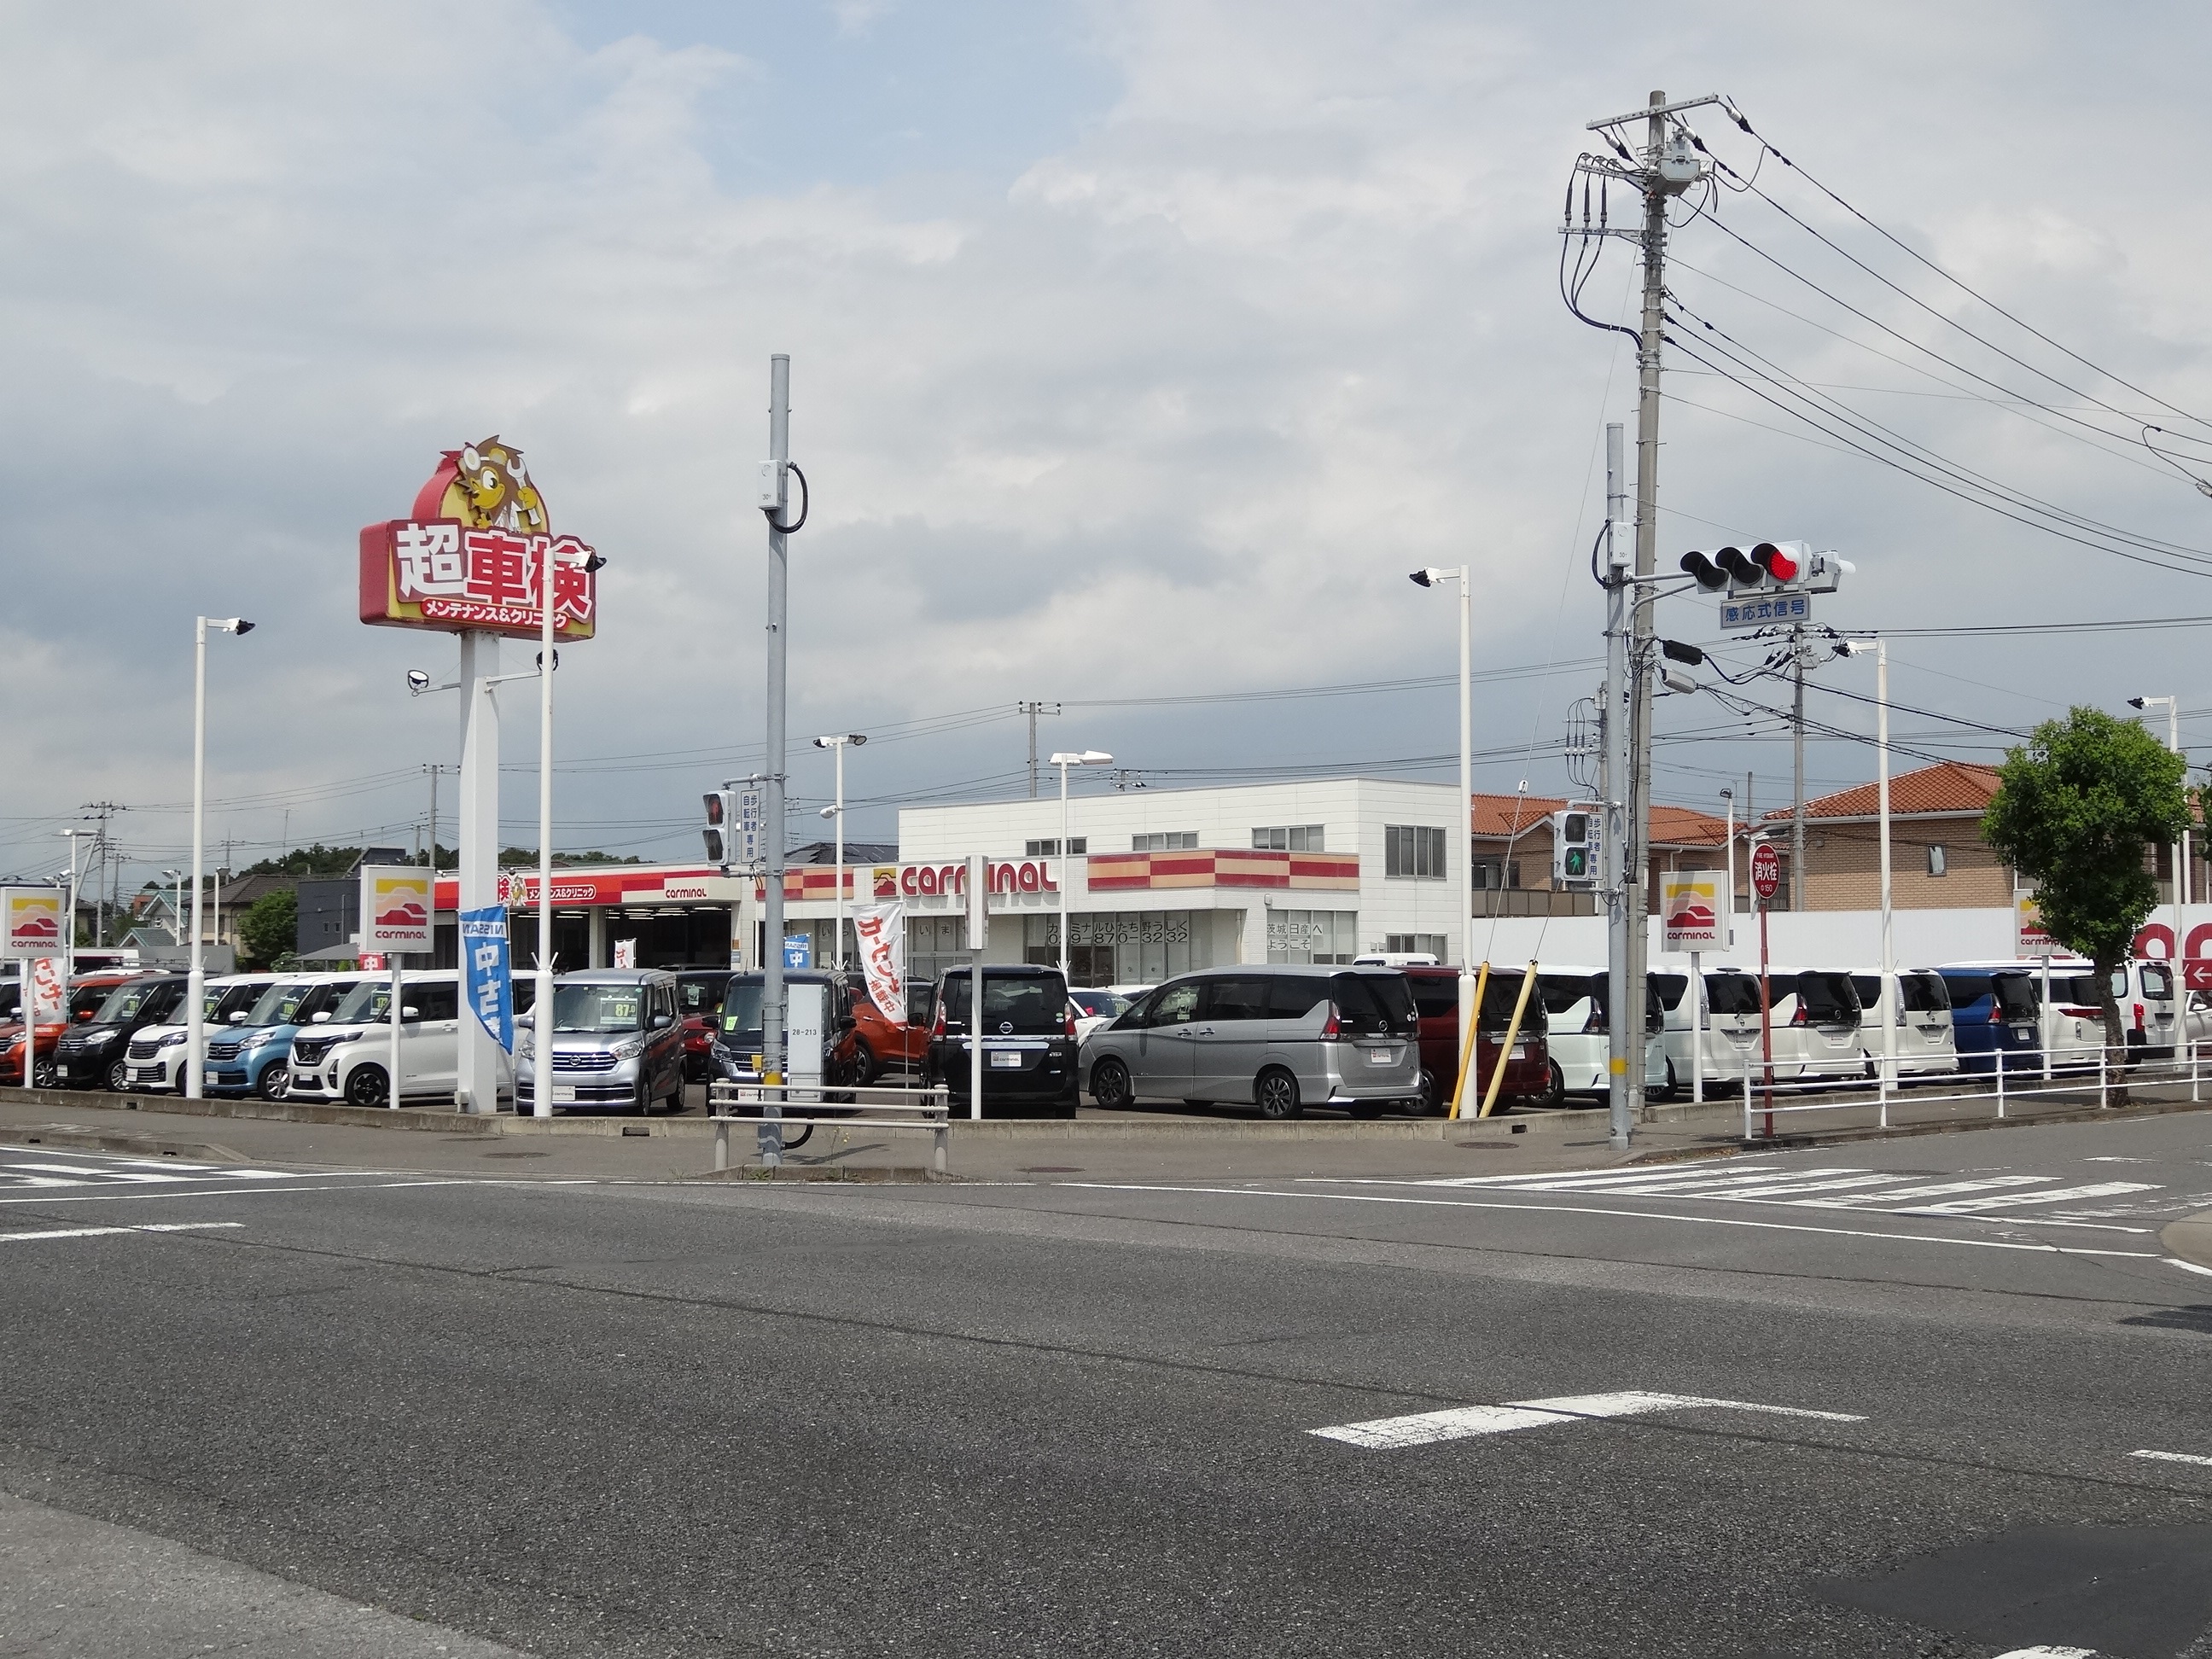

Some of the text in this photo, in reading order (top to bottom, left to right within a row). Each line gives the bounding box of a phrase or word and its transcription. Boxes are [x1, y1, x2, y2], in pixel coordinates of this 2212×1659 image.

[396, 523, 593, 624] 超車検
[427, 600, 567, 629] メンテナンス&クリニク
[1726, 599, 1805, 622] 感応式信号
[747, 835, 754, 859] 専用
[1755, 861, 1778, 881] 消火栓
[529, 887, 595, 899] メンンス&クリニック
[666, 888, 707, 898] carminal
[1049, 920, 1188, 933] カミナルひたち野うしく
[1267, 923, 1322, 934] 茨城日産へ
[375, 930, 427, 939] carminal
[1267, 940, 1310, 950] ようこそ
